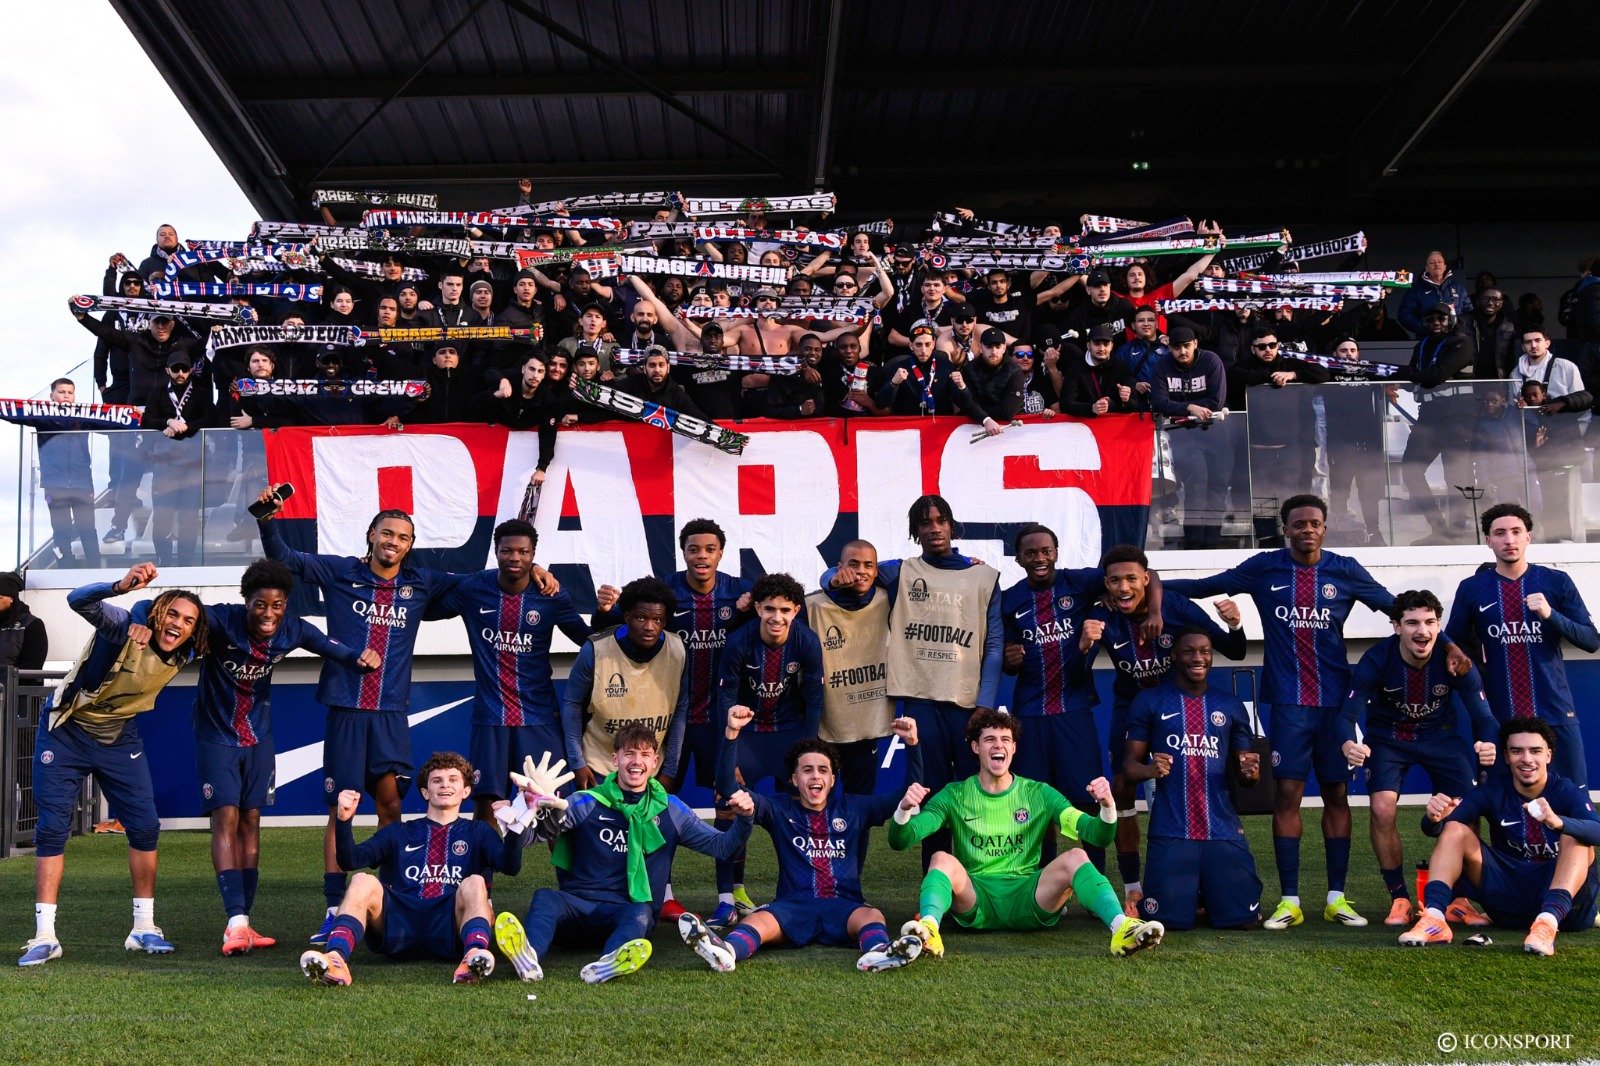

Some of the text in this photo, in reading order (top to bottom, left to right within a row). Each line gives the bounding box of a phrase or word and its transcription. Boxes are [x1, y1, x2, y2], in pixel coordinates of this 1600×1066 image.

[415, 238, 472, 257] AUTEUIL
[779, 229, 842, 249] RAS
[1169, 239, 1198, 249] GAZA
[1294, 236, 1358, 259] D'EUROPE
[621, 255, 788, 285] VIRAGE AUTEUIL
[949, 254, 1069, 271] PARIS
[1359, 271, 1389, 281] GAZA
[686, 305, 758, 319] URBAN
[1164, 298, 1235, 315] URBAN
[379, 326, 514, 342] VIRAGE AUTEUIL
[350, 380, 408, 395] CREW
[22, 401, 134, 426] MARSEILLAIS
[311, 421, 1102, 617] PARIS
[908, 591, 930, 599] YOUTH
[351, 600, 407, 620] QATAR
[1275, 605, 1331, 622] QATAR
[365, 614, 407, 629] AIRWAYS
[1022, 617, 1074, 642] QATAR
[1288, 618, 1331, 630] AIRWAYS
[1486, 620, 1543, 638] QATAR
[481, 627, 533, 646] QATAR
[675, 627, 727, 645] QATAR
[822, 638, 846, 648] YOUTH
[904, 622, 974, 649] #FOOTBALL
[1034, 629, 1075, 646] AIRWAYS
[1500, 633, 1544, 645] AIRWAYS
[492, 642, 532, 653] AIRWAYS
[688, 639, 727, 650] AIRWAYS
[927, 651, 958, 661] RESPECT
[1118, 654, 1171, 673] QATAR
[828, 662, 888, 689] #FOOTBA
[605, 687, 628, 695] YOUTH
[1166, 733, 1219, 751] QATAR
[1180, 747, 1219, 759] AIRWAYS
[791, 836, 846, 850] QATAR
[969, 833, 1025, 850] QATAR
[805, 848, 847, 860] AIRWAYS
[984, 845, 1025, 858] AIRWAYS
[404, 865, 463, 881] QATAR
